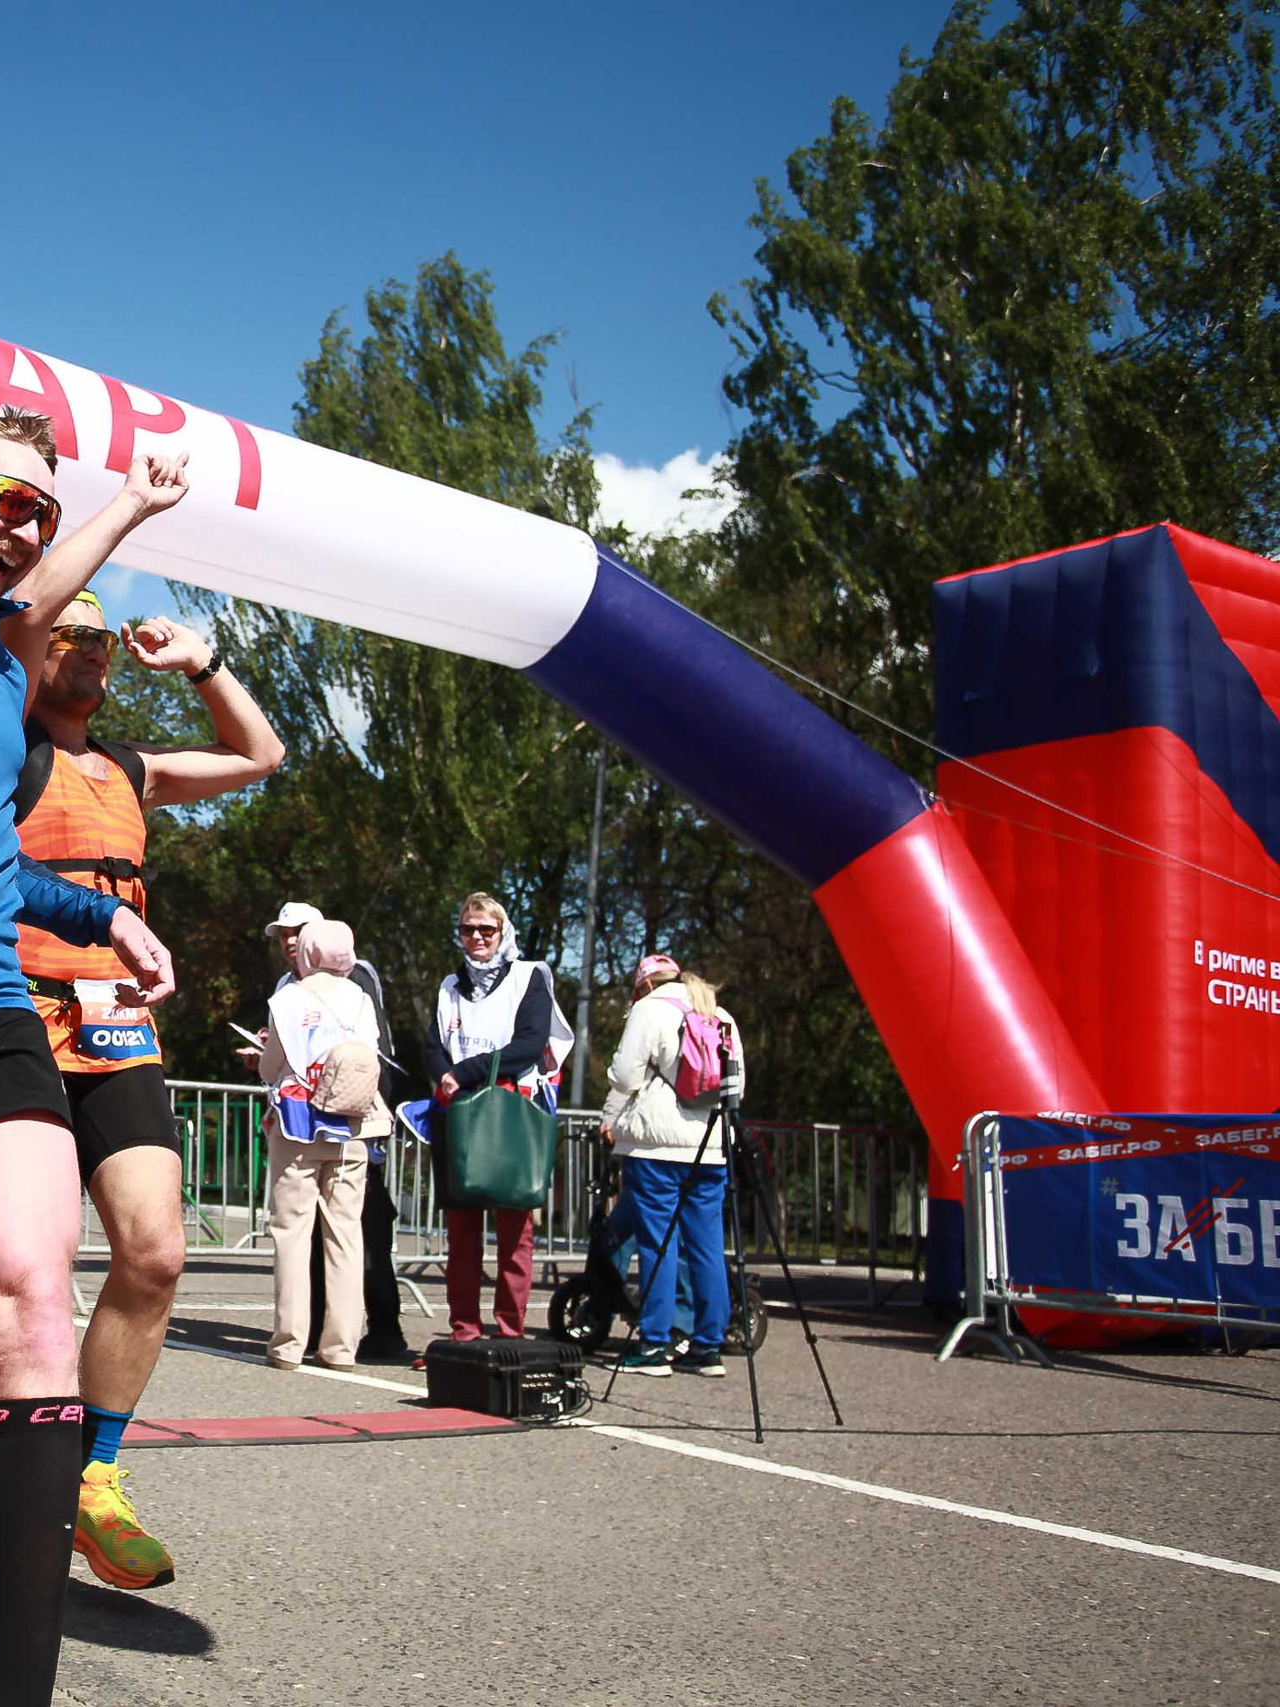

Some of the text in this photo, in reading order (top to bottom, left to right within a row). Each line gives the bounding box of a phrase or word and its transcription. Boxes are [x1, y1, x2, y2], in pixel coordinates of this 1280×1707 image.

[1194, 940, 1204, 966] В
[1208, 949, 1266, 978] ритме
[1057, 1140, 1162, 1161] ЗАБЕГ.РФ
